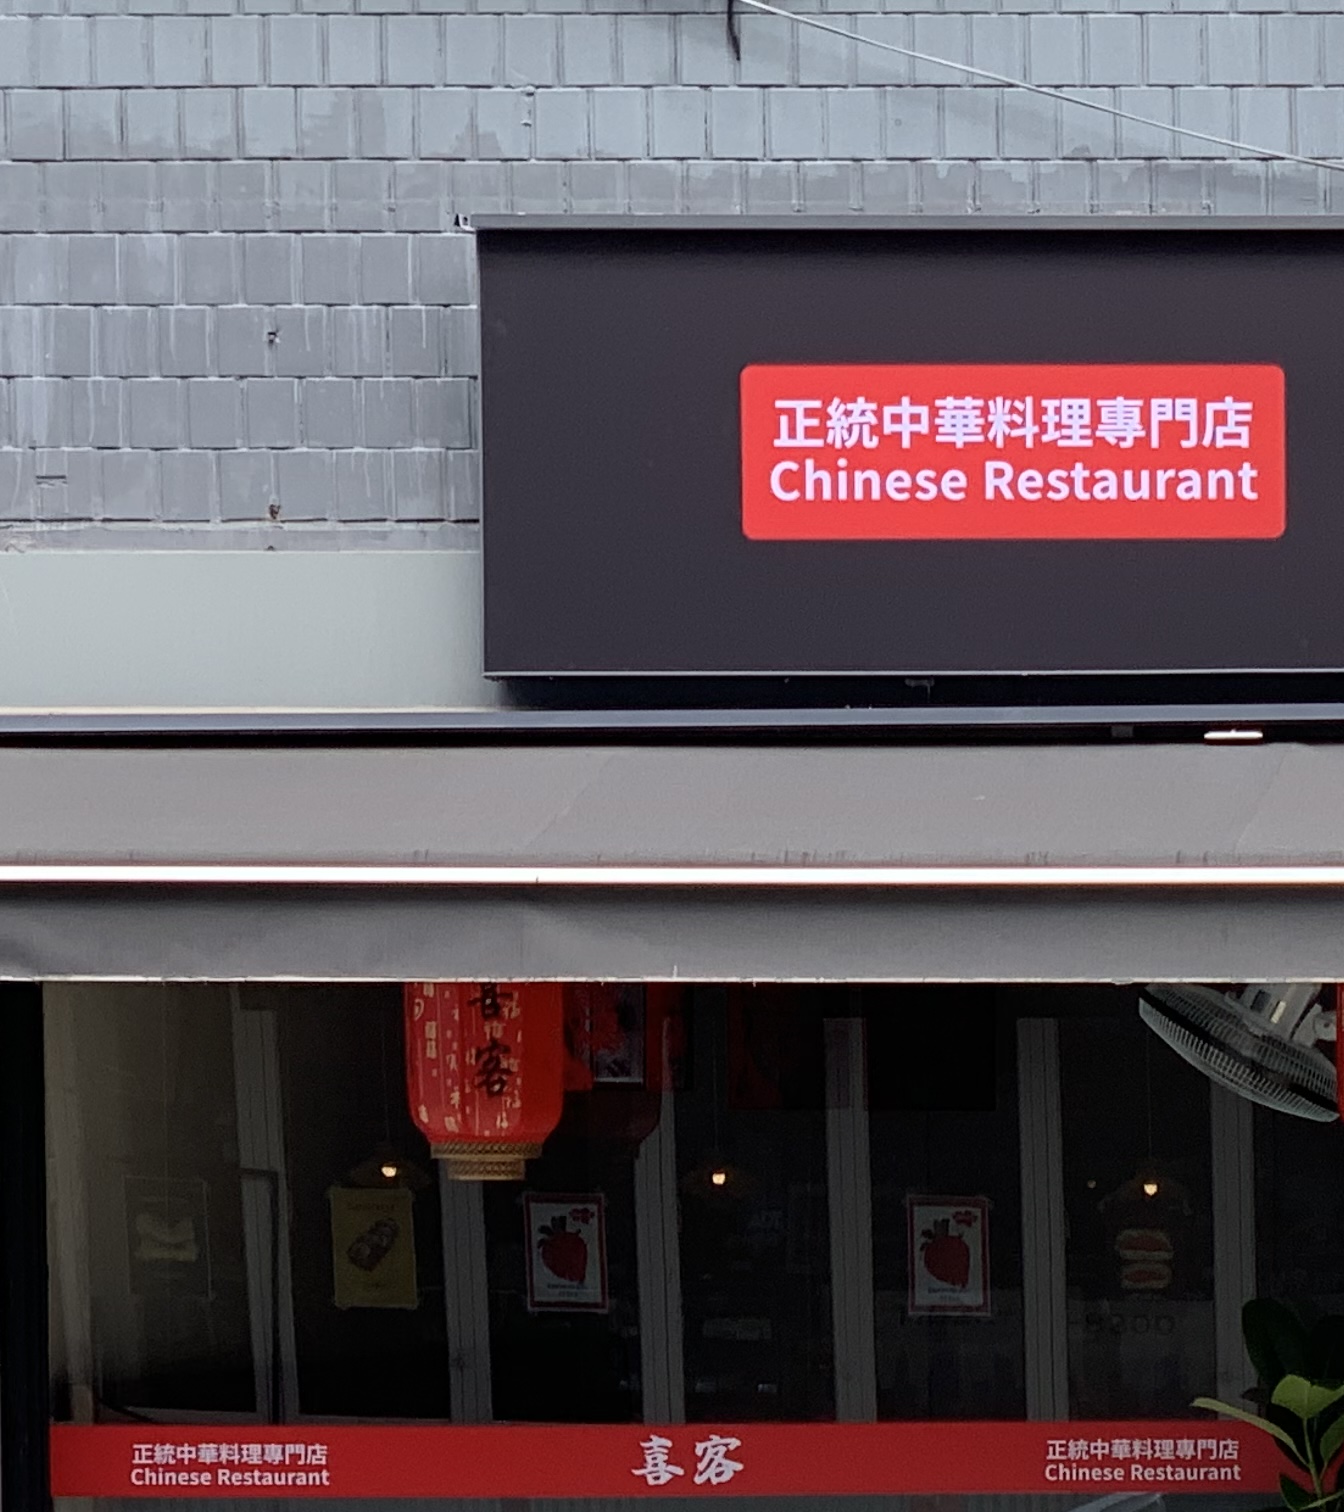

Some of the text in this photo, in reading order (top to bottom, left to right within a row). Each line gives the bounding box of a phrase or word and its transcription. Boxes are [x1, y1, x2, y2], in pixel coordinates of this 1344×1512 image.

[773, 396, 1254, 449] 正統中華料理專門店
[770, 459, 1259, 502] Chinese Restaurant
[132, 1443, 328, 1466] 正統中華料理專門店
[632, 1435, 745, 1487] 喜客
[1046, 1438, 1240, 1461] 正統中華料理專門店
[131, 1468, 330, 1487] Chinese Restaurant
[1045, 1463, 1242, 1482] Chinese Restaurant
